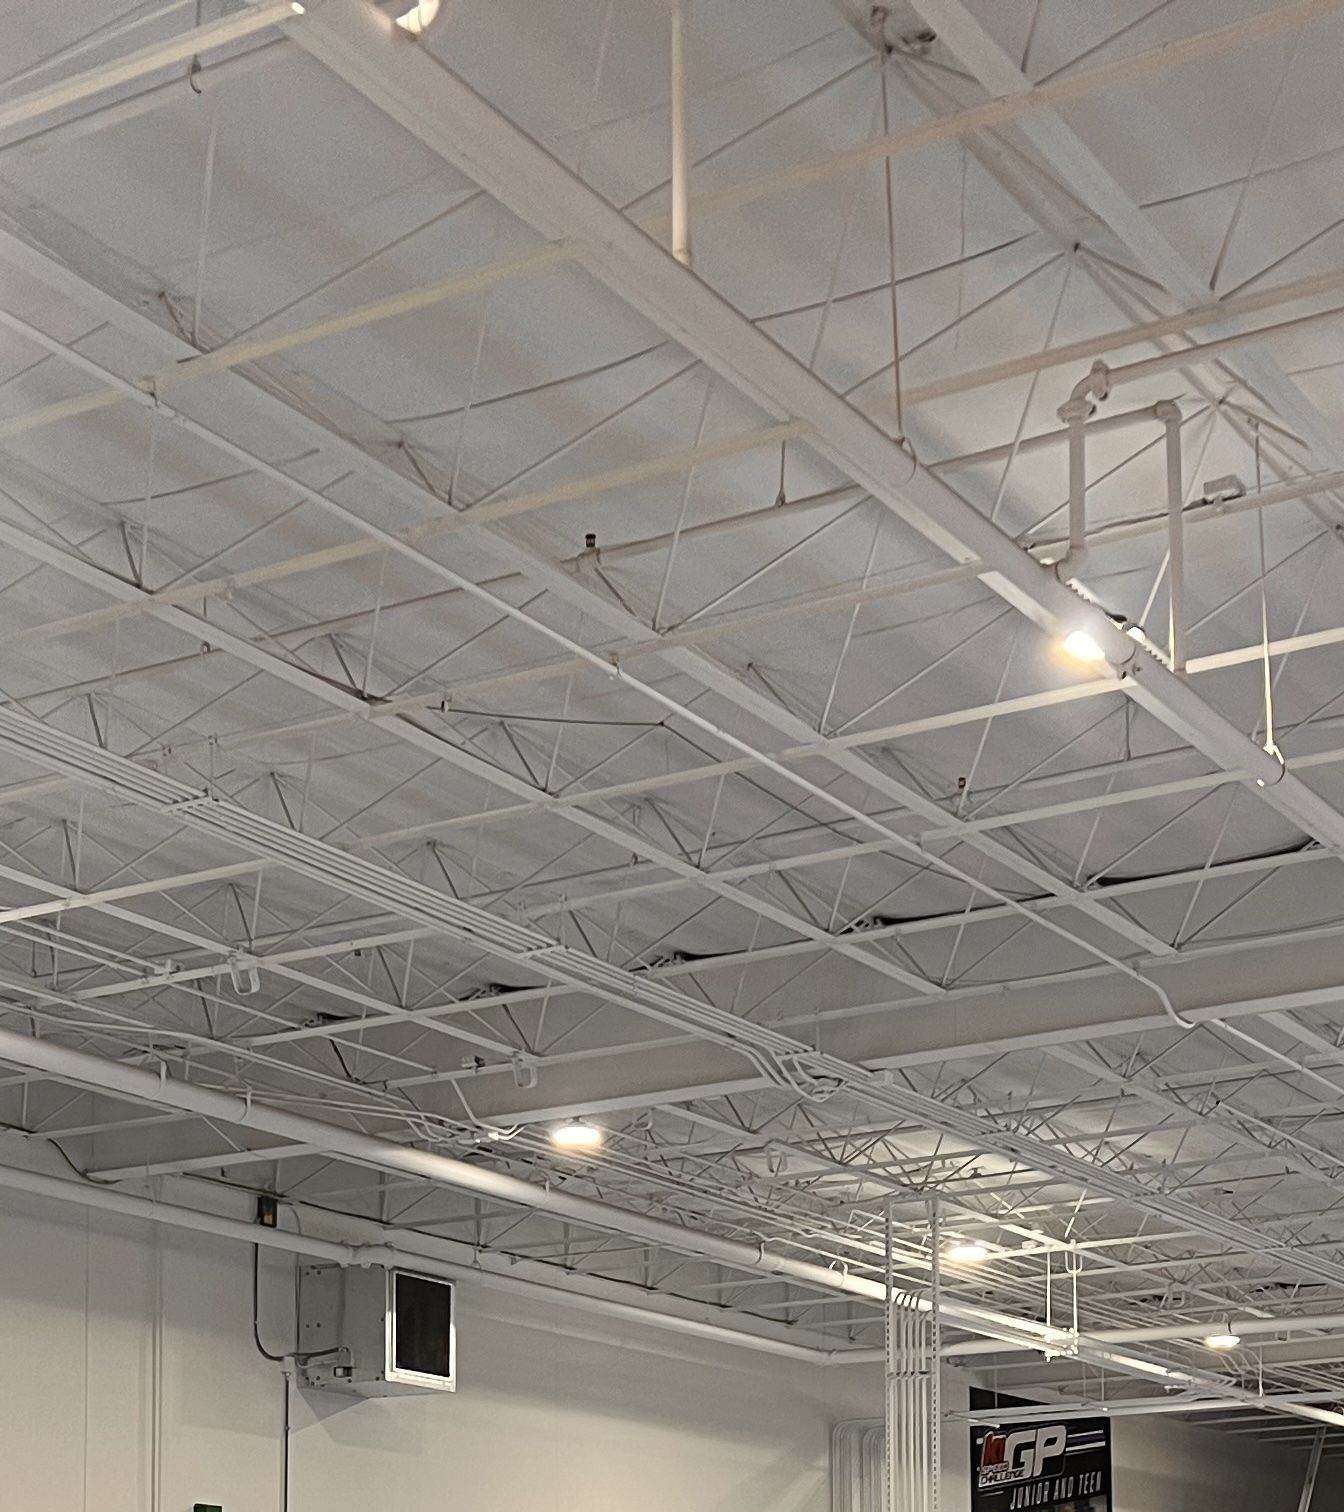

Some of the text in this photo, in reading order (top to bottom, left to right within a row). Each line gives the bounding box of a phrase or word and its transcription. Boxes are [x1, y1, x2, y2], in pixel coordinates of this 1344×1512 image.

[1005, 1424, 1067, 1479] GP
[1010, 1470, 1103, 1511] JUNIOR AND TEEN
